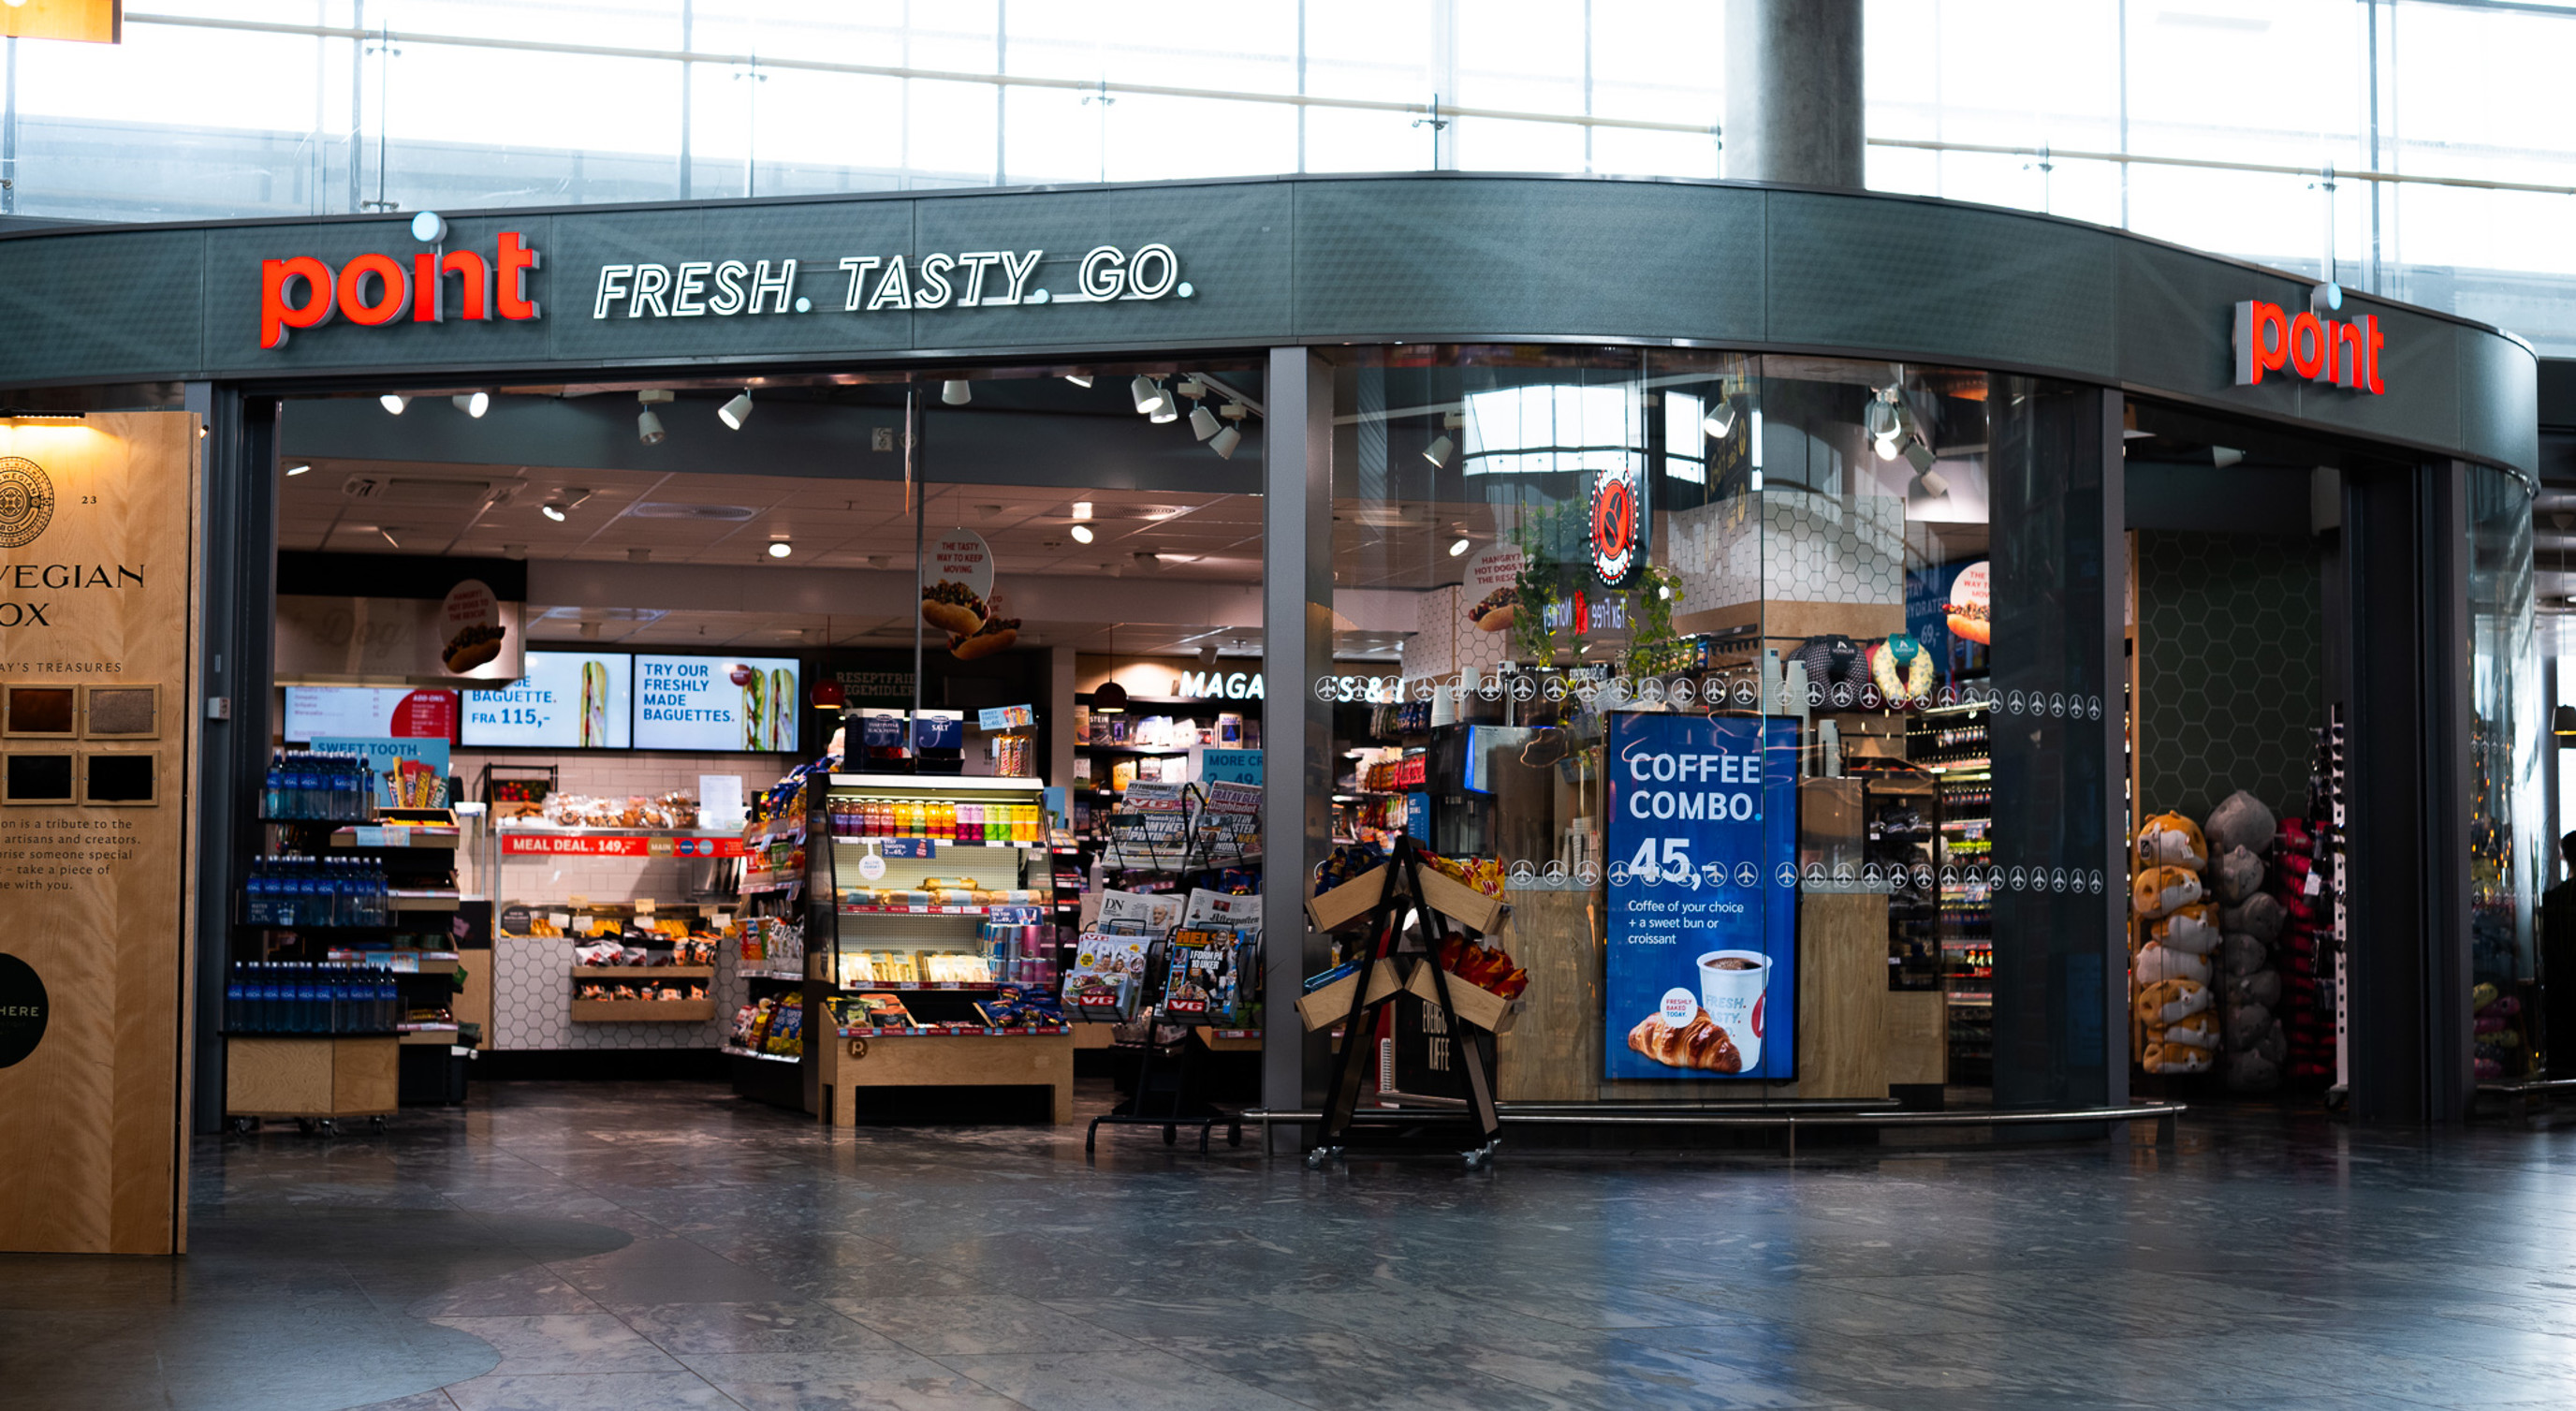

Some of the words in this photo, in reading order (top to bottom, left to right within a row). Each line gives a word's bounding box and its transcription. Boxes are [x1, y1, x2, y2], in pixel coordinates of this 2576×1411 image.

[261, 212, 534, 349] point
[593, 258, 812, 318] FRESH.
[839, 250, 1049, 312] TASTY.
[1078, 243, 1193, 301] GO.
[2251, 282, 2385, 395] point
[943, 542, 956, 551] THE
[937, 553, 951, 562] WAY
[1482, 553, 1520, 564] HANGRY?
[944, 566, 973, 574] MOVING.
[1494, 566, 1516, 574] DOGS
[1969, 571, 1985, 580] THE
[37, 662, 122, 673] TREASURES
[644, 664, 672, 676] TRY
[677, 666, 709, 677] OUR
[644, 679, 709, 692] FRESHLY
[644, 694, 685, 706] MADE
[472, 714, 496, 724] FRA
[501, 709, 550, 728] 115,-
[643, 708, 735, 722] BAGUETTES.
[371, 744, 421, 757] TOOTH.
[1209, 756, 1244, 766] MORE
[1630, 753, 1761, 783] COFFEE
[1209, 801, 1256, 813] Dagbladet
[1630, 791, 1762, 821] COMBO.
[21, 818, 30, 830] is
[35, 820, 41, 830] a
[47, 818, 90, 830] tribute
[95, 820, 108, 830] to
[112, 818, 133, 830] the
[5, 835, 53, 844] artisans
[58, 833, 80, 844] and
[85, 835, 140, 845] creators.
[513, 839, 550, 850] MEAL
[554, 841, 593, 851] DEAL.
[598, 841, 632, 854] 149,-
[30, 850, 84, 860] someone
[89, 849, 133, 861] special
[17, 865, 44, 875] take
[60, 865, 93, 876] piece
[97, 864, 110, 875] of
[1629, 838, 1717, 890] 45,-
[15, 879, 42, 889] with
[47, 881, 73, 891] you.
[1105, 898, 1124, 910] DN
[1629, 900, 1664, 912] Coffee
[1668, 901, 1679, 912] of
[1682, 903, 1705, 918] your
[1708, 901, 1744, 913] choice
[1639, 919, 1646, 928] a
[1649, 918, 1680, 928] sweet
[1684, 918, 1704, 928] bun
[1629, 934, 1676, 945] croissant
[1171, 1001, 1204, 1010] VG
[1706, 994, 1747, 1008] FRESH.
